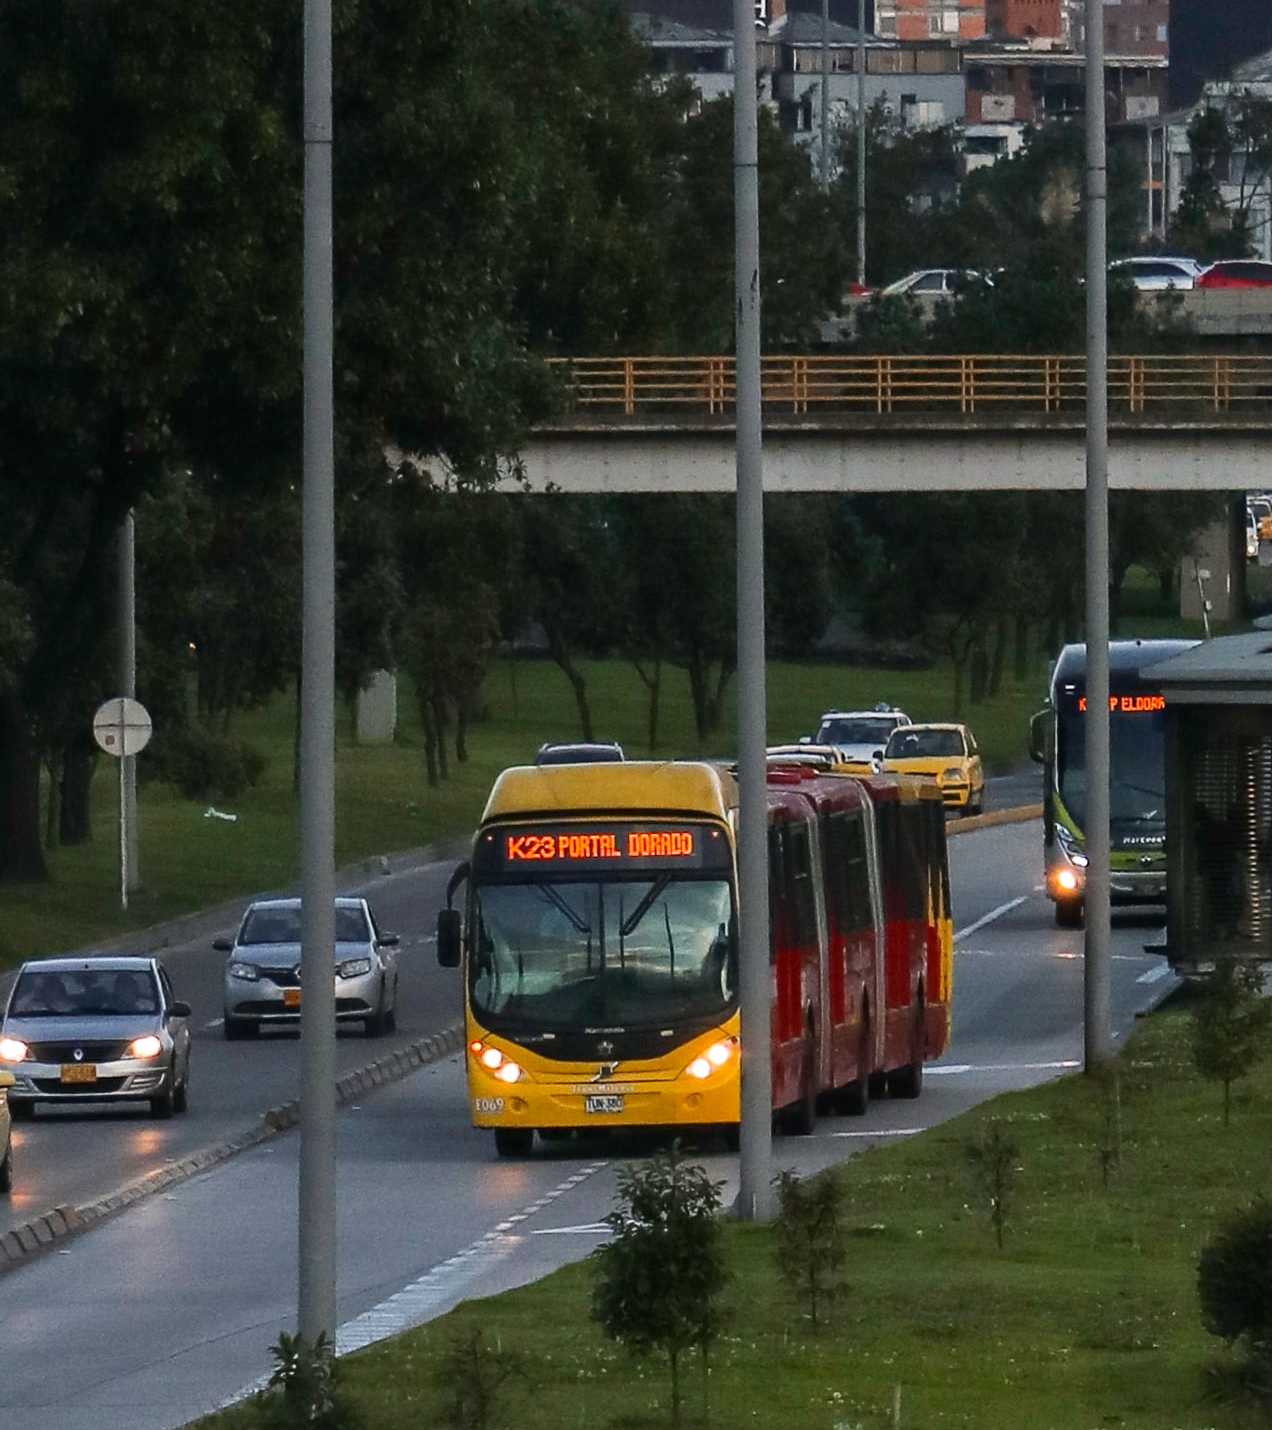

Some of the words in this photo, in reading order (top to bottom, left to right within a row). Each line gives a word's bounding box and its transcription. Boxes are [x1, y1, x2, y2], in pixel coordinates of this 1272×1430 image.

[508, 835, 555, 860] K23
[558, 833, 622, 859] PORTAL
[628, 831, 694, 857] DORADO
